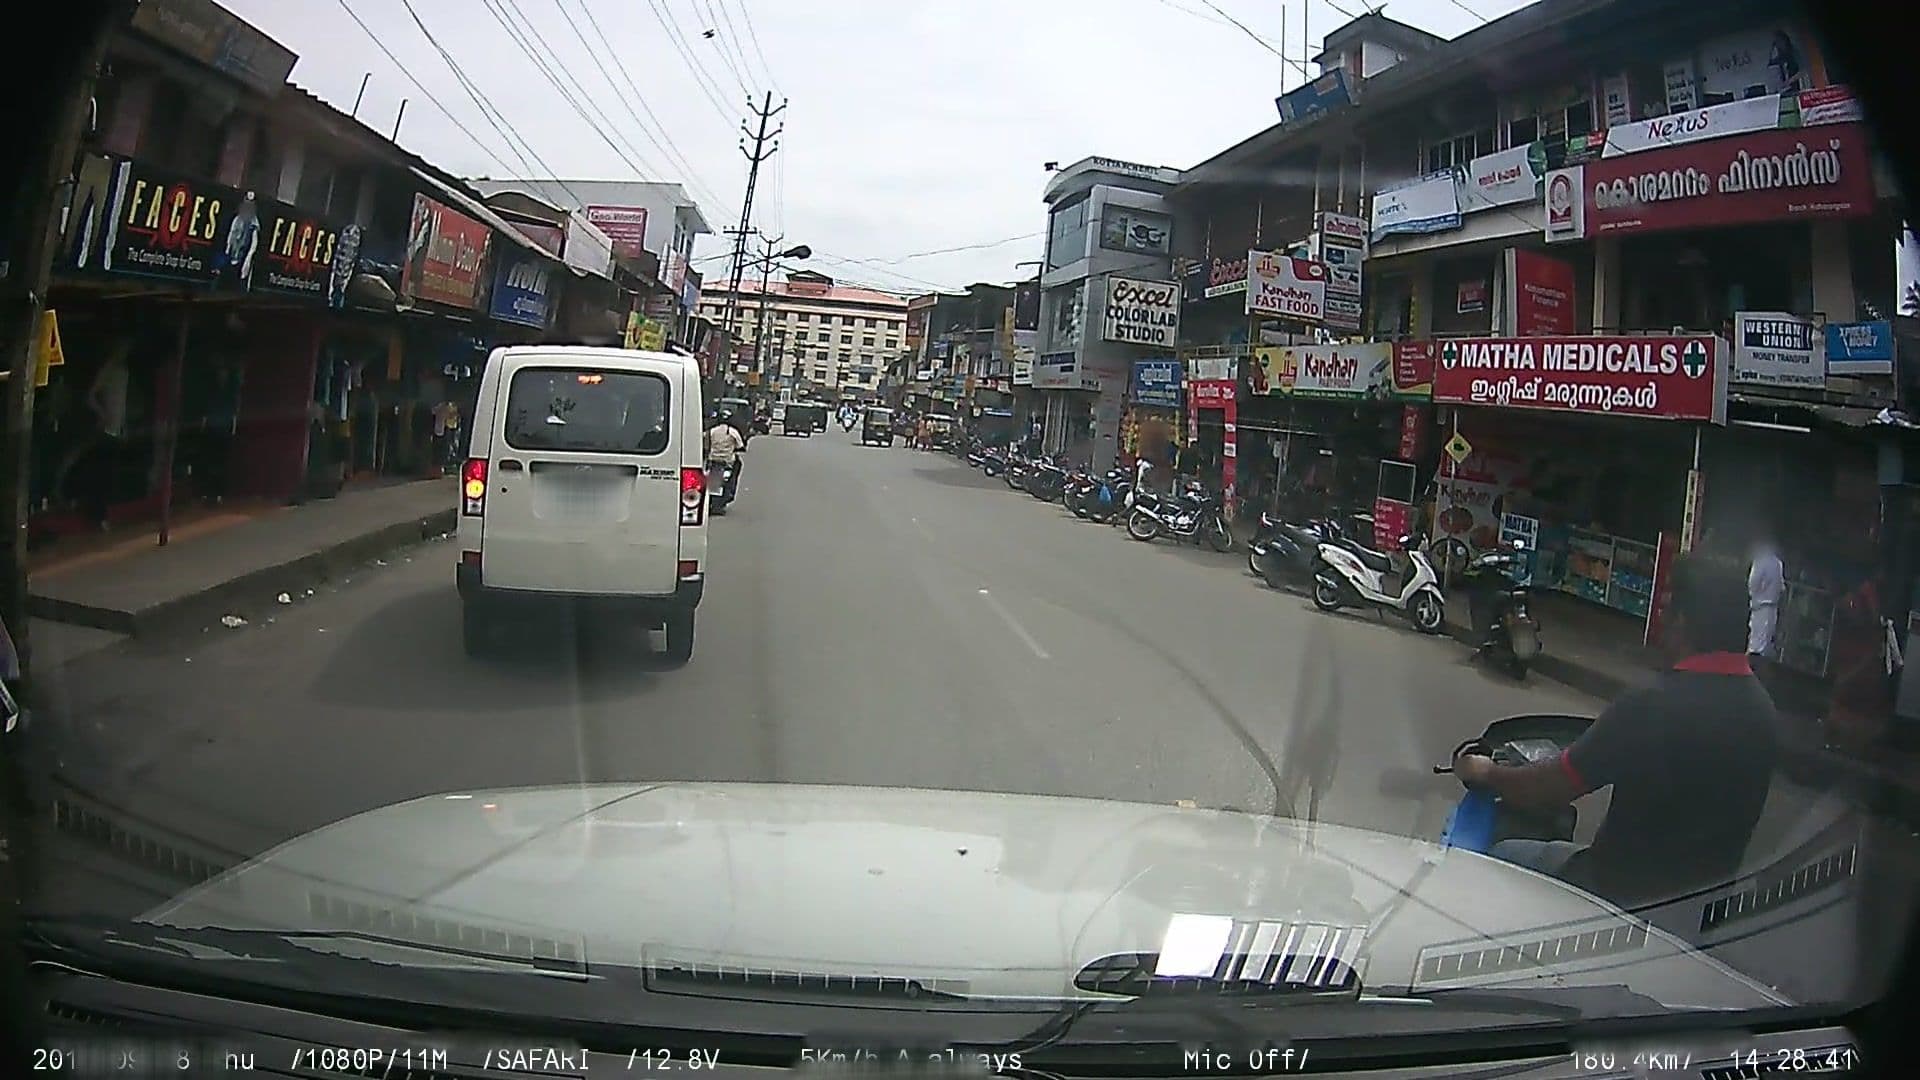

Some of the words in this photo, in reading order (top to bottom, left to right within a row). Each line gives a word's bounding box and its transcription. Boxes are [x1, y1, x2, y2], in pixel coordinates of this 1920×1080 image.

[128, 180, 220, 239] FACES
[269, 218, 335, 265] FACES
[1113, 281, 1175, 308] Excel
[1256, 294, 1283, 309] FAST
[1287, 300, 1319, 315] FOOD
[1107, 305, 1176, 327] COLORLAB
[1115, 324, 1165, 343] STUDIO
[1746, 322, 1801, 336] WESTERN
[1762, 335, 1801, 348] UNION
[1461, 344, 1535, 369] MATHA
[1543, 344, 1678, 374] MEDICALS
[1544, 382, 1657, 411] മരുന്നുകൾ
